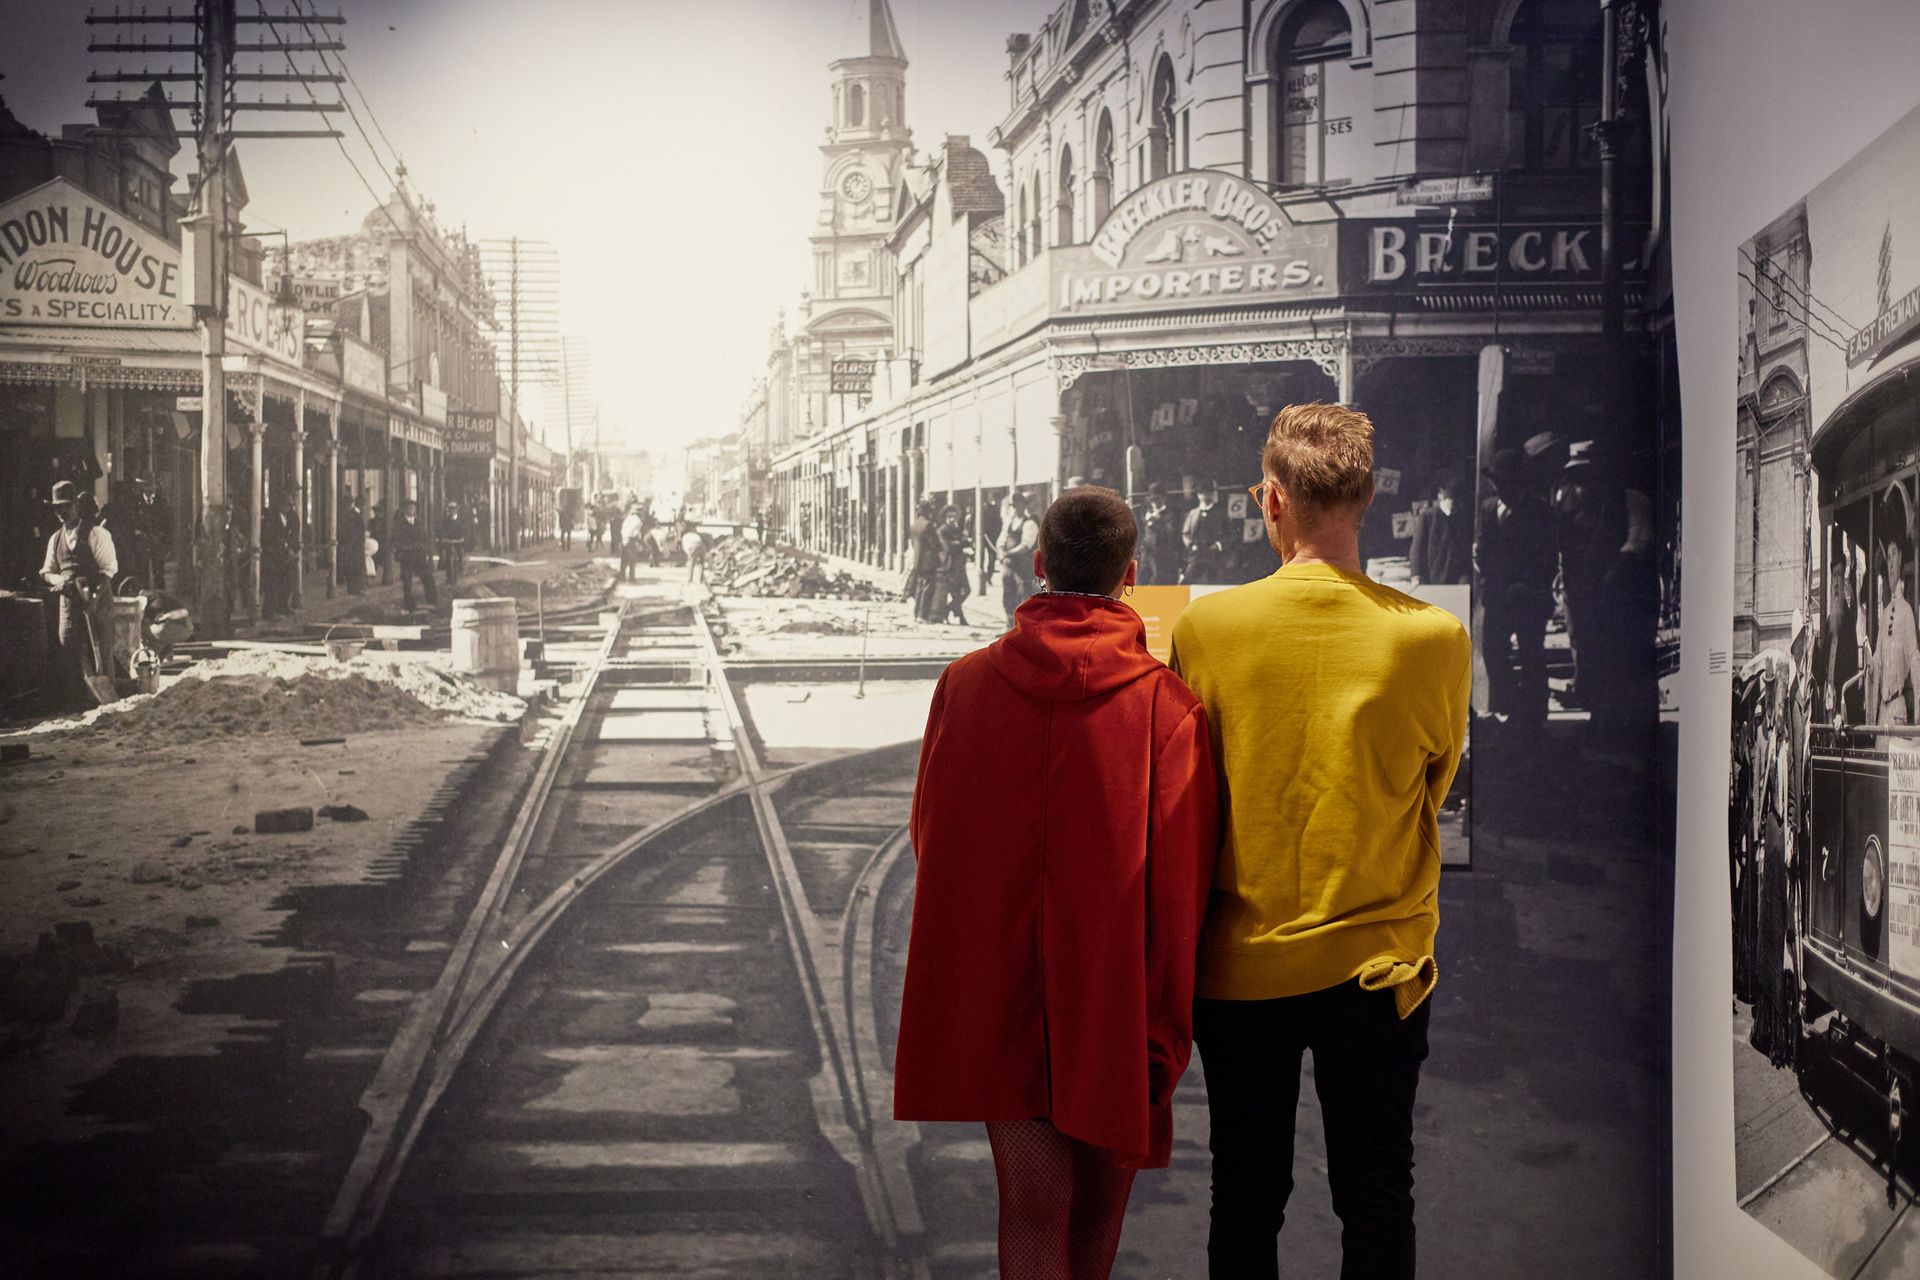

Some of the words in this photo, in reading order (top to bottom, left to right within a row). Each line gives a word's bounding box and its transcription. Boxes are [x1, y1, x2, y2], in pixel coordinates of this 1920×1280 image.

[81, 206, 179, 299] HOUSE
[47, 298, 176, 321] SPECIALITY.
[1849, 322, 1877, 361] EAST
[1878, 286, 1920, 341] FREMAN
[456, 413, 494, 433] BEARD
